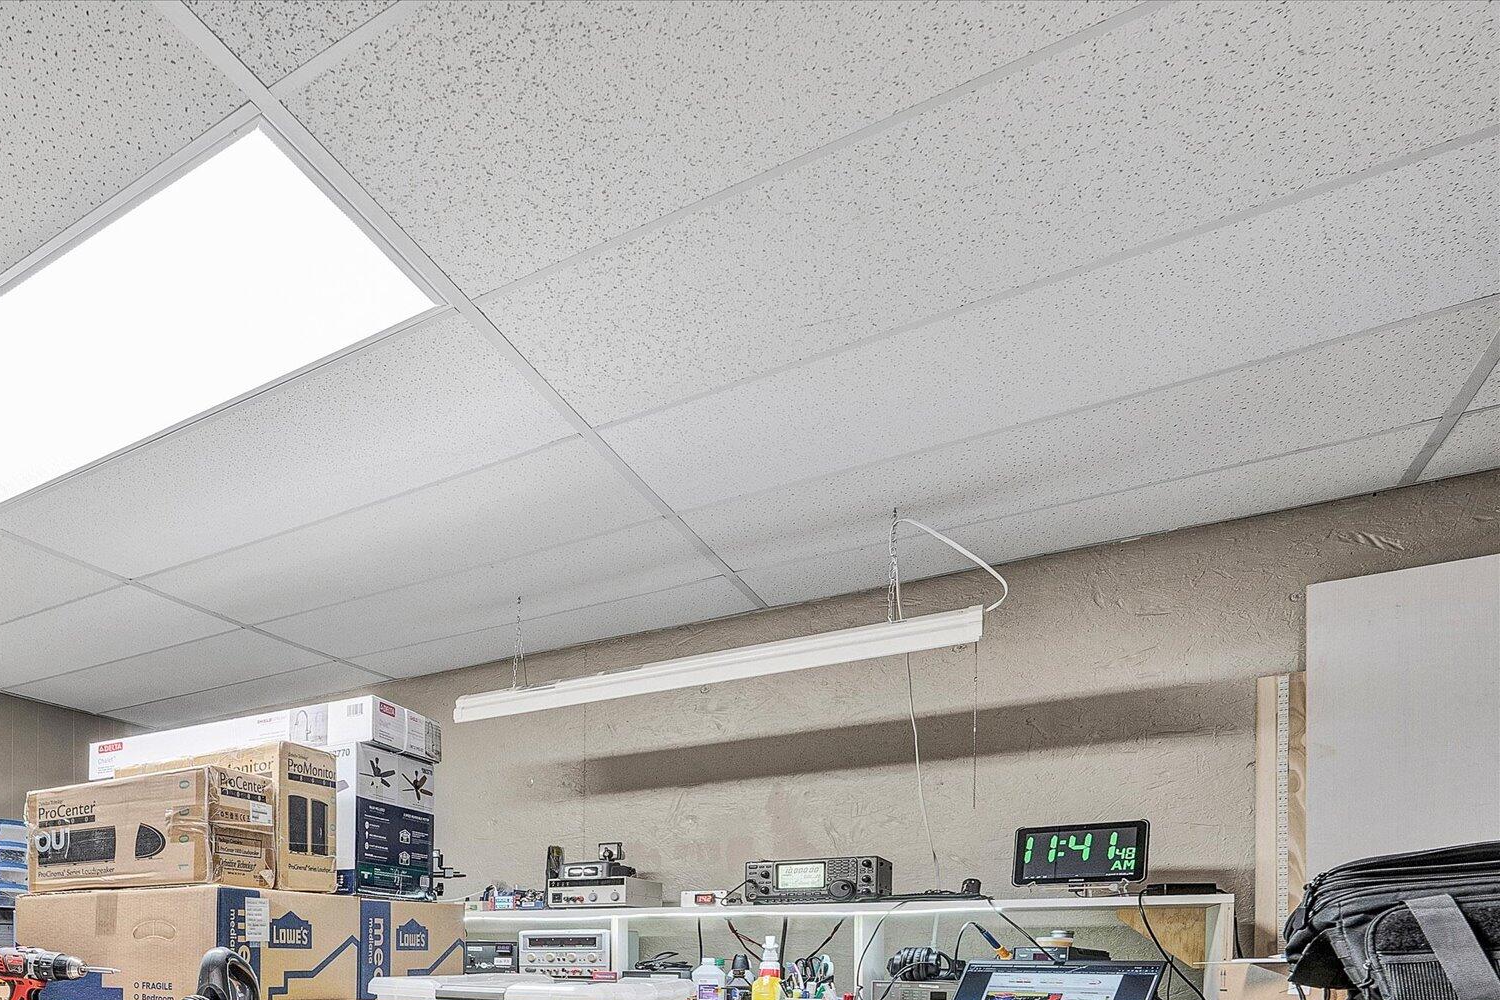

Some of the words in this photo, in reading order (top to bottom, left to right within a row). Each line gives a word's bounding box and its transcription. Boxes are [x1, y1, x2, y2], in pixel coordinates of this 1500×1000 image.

[103, 743, 122, 752] DELTA
[288, 758, 336, 780] ProMonitor
[220, 772, 266, 793] ProCenter
[39, 804, 95, 820] ProCenter
[1024, 832, 1118, 864] 11:41
[1116, 847, 1136, 859] 48
[1111, 860, 1135, 871] AM
[273, 926, 308, 945] LOWE'S
[400, 932, 426, 947] LOWE'S
[142, 982, 173, 990] FRAGILE
